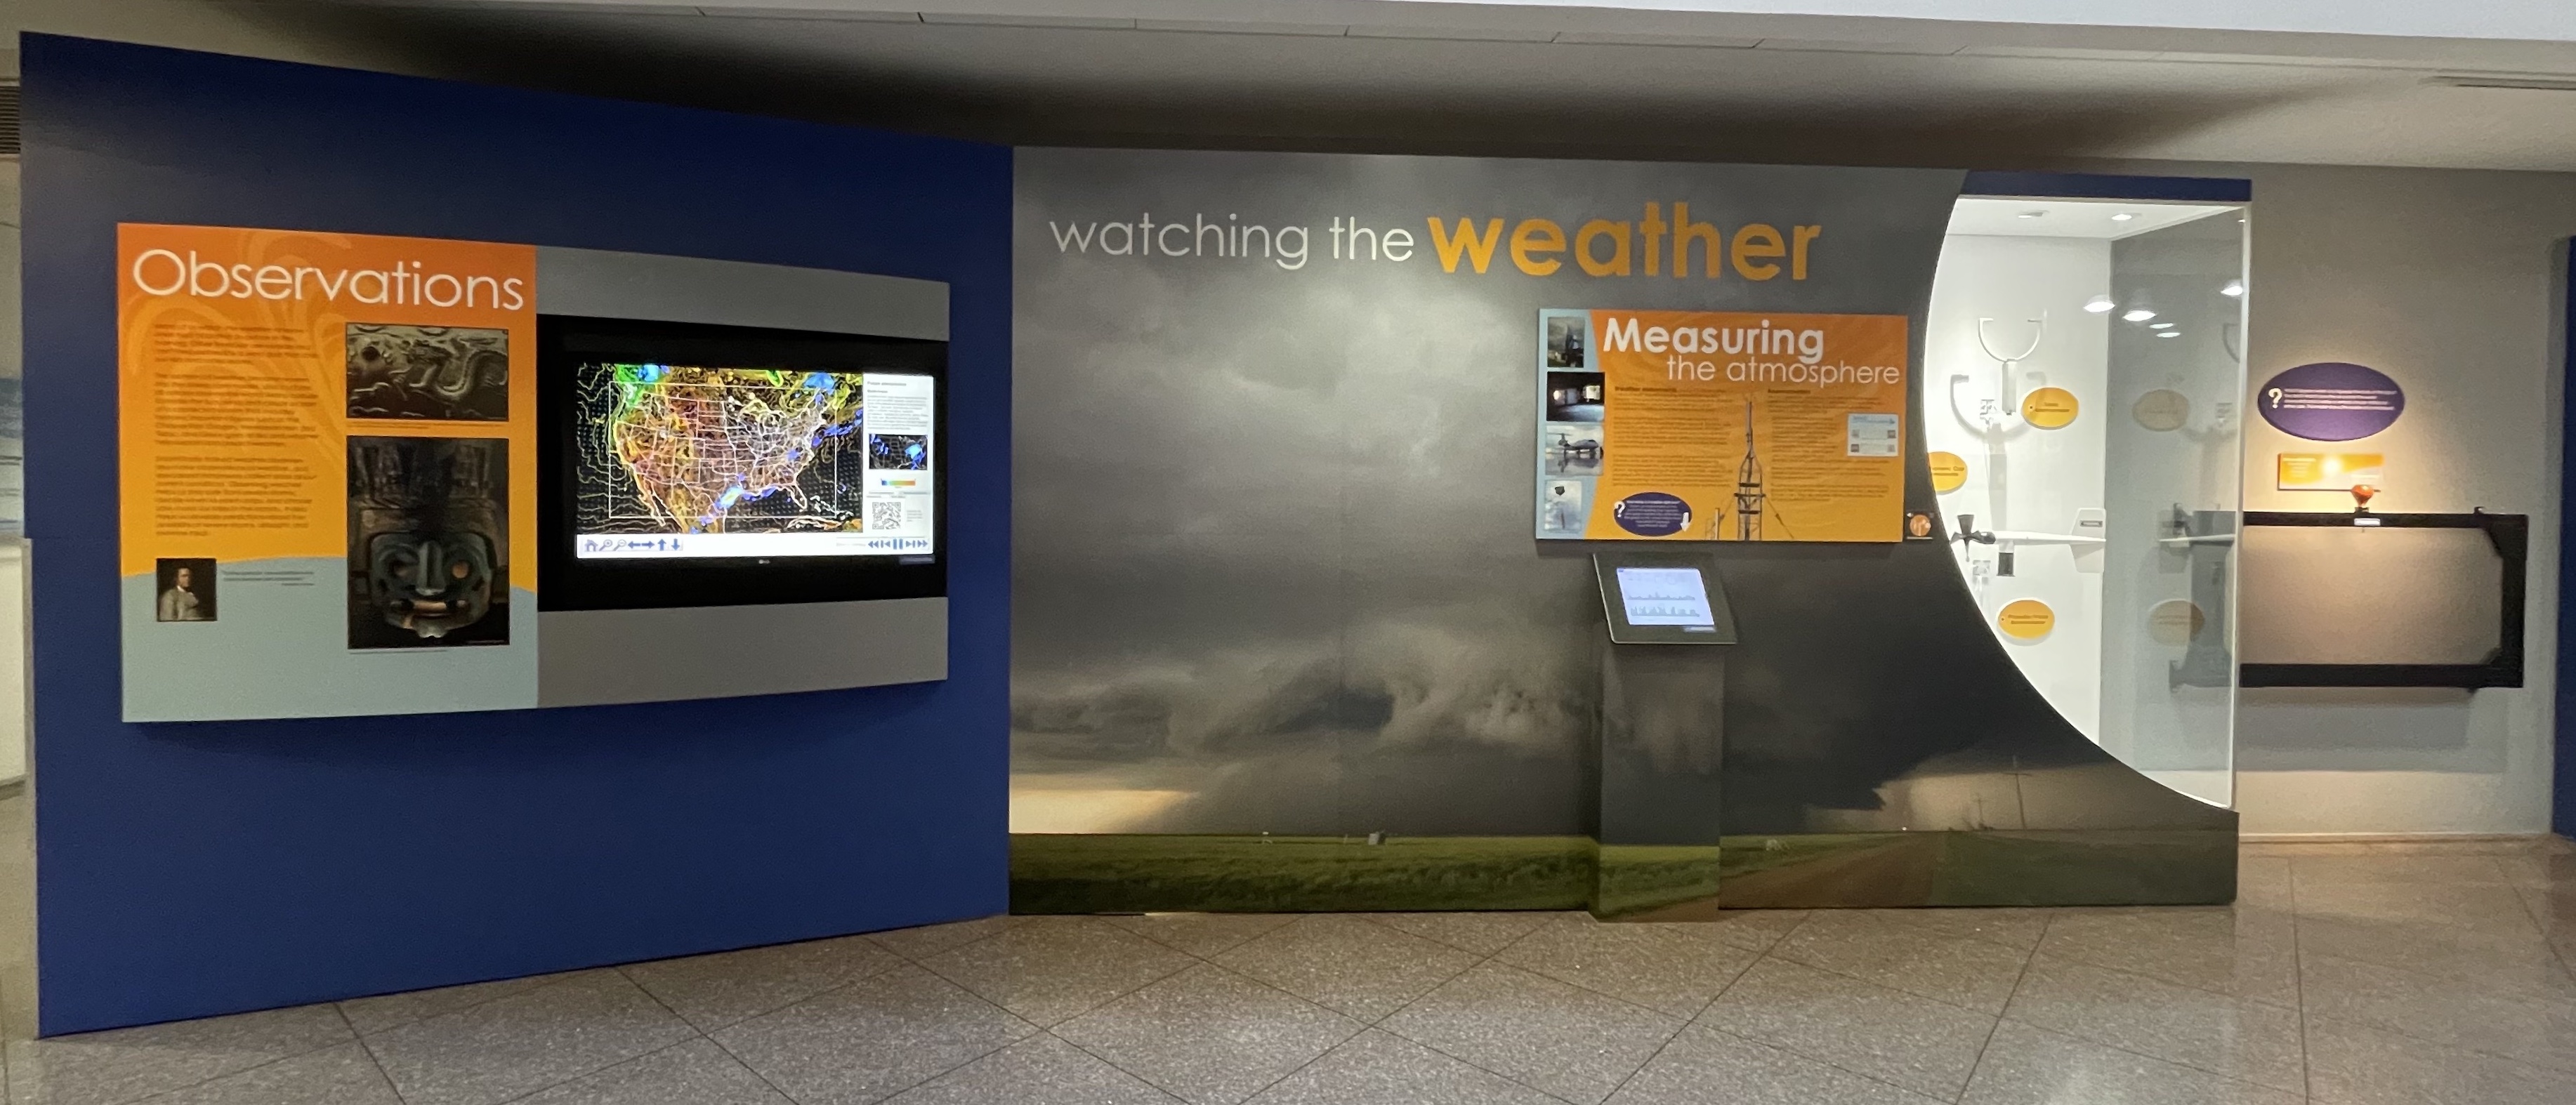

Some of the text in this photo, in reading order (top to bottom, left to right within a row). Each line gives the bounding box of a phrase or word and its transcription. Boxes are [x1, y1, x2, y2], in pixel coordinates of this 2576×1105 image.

[1050, 202, 1820, 280] watching the weather
[132, 248, 525, 311] Observations
[1603, 318, 1824, 365] Measuring
[1667, 355, 1900, 388] the atmosphere
